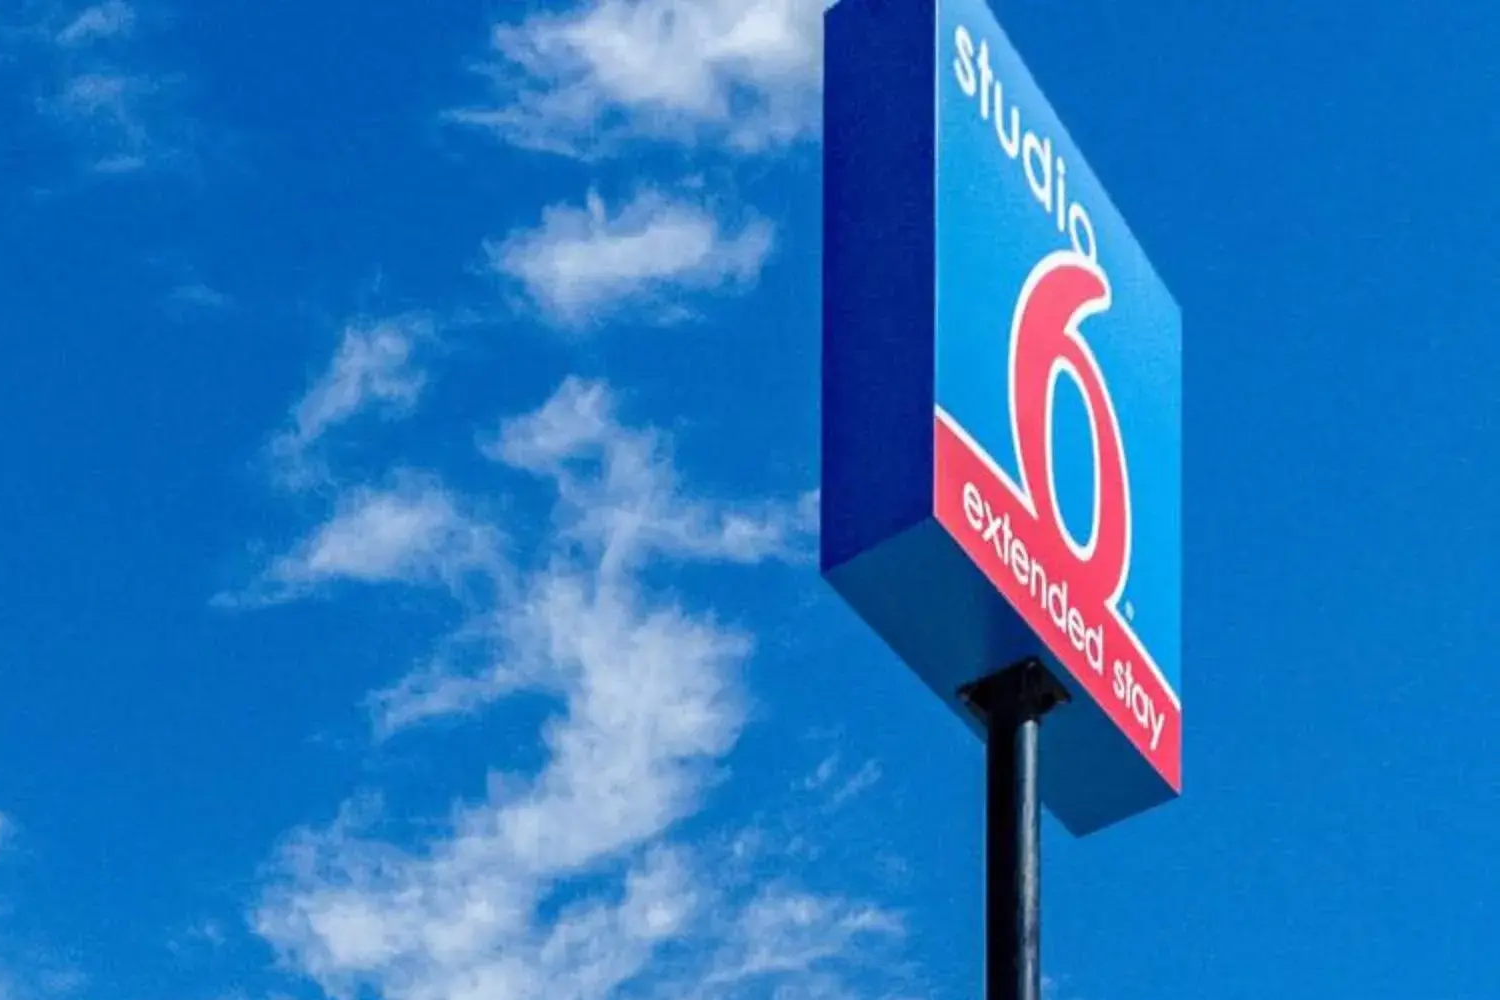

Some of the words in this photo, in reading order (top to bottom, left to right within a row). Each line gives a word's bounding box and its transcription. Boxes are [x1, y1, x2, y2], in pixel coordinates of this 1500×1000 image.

[954, 25, 1098, 266] studio
[1008, 249, 1132, 608] 6
[963, 481, 1105, 676] extended
[1111, 658, 1165, 751] stay
